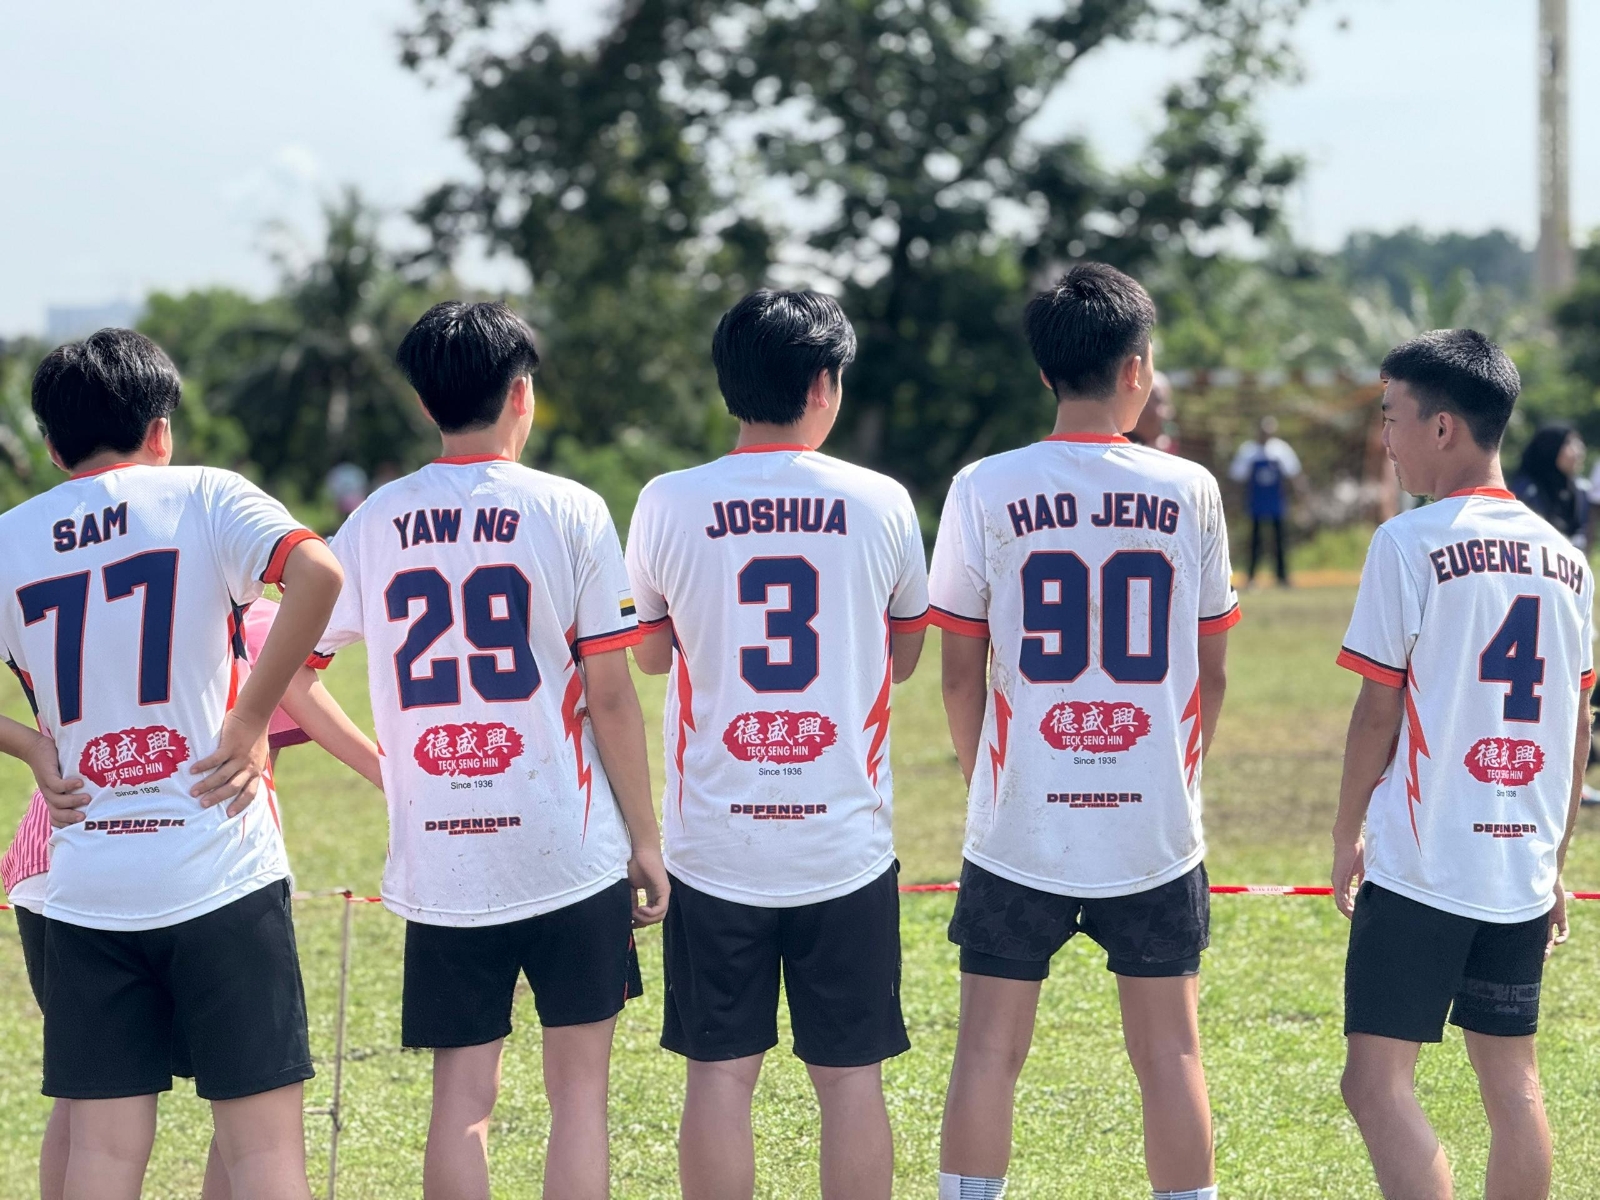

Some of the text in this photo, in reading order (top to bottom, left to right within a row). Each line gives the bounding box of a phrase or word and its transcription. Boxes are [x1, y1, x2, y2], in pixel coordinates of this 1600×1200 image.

[52, 501, 128, 553] SAM
[392, 507, 521, 550] YAW NG
[705, 498, 848, 539] JOSHUA
[1007, 492, 1180, 537] HAO JENG
[1429, 538, 1583, 595] EUGENE LOH
[738, 555, 820, 694] 3
[1018, 549, 1176, 684] 90
[15, 548, 180, 727] 77
[383, 563, 542, 711] 29
[1478, 594, 1546, 723] 4
[733, 714, 826, 745] 德盛興
[1049, 705, 1139, 735] 德盛興
[88, 731, 176, 773] 德盛興
[423, 726, 512, 759] 德盛興
[746, 745, 809, 756] TECK SENG HIN
[1061, 735, 1123, 746] TECK SENG HIN
[119, 766, 143, 779] SENG
[145, 762, 163, 775] HIN
[437, 757, 499, 771] TECK SENG HIN
[758, 767, 803, 776] Since 1936
[1073, 756, 1117, 765] Since 1936
[1510, 770, 1523, 780] HIN
[114, 786, 160, 798] Since 1936
[450, 780, 493, 790] Since 1936
[1046, 793, 1143, 803] DEFENDER
[84, 818, 186, 831] DEFENDER
[425, 816, 521, 831] DEFENDER
[730, 804, 827, 815] DEFENDER
